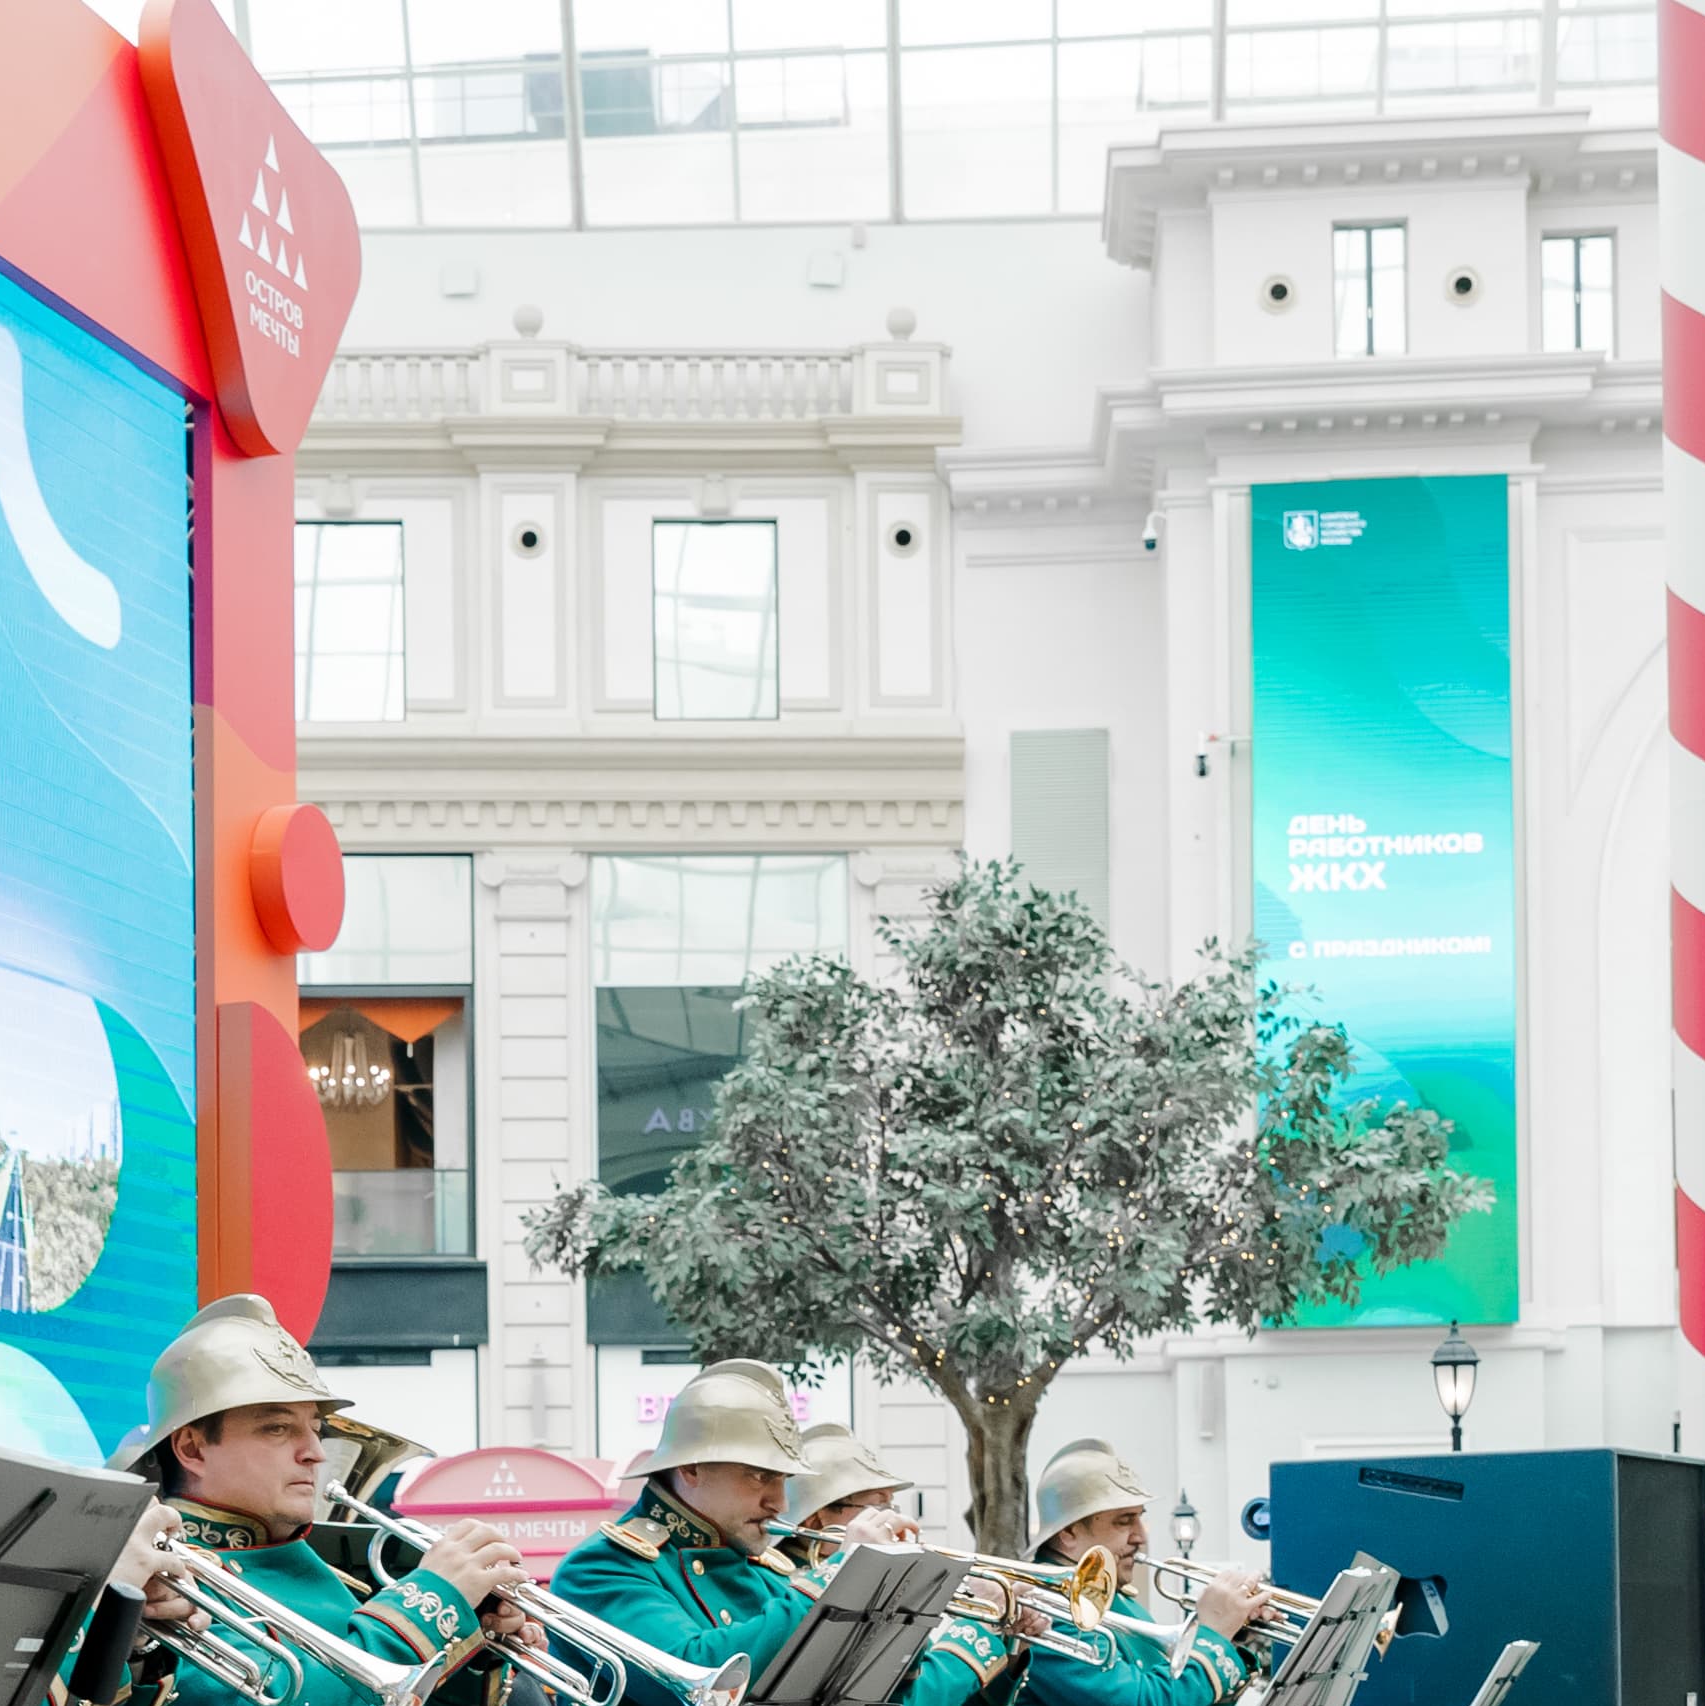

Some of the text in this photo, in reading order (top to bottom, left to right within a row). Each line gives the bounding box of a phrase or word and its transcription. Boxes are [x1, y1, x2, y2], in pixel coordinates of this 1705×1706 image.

[245, 270, 303, 330] ОСТРОВ
[249, 303, 300, 358] МЕЧТЫ
[1287, 814, 1367, 836] ДЕНЬ
[1288, 832, 1484, 858] РАБОТНИКОВ
[1288, 860, 1387, 893] ЖКХ
[1288, 940, 1307, 959] С
[514, 1519, 587, 1539] МЕЧТЫ
